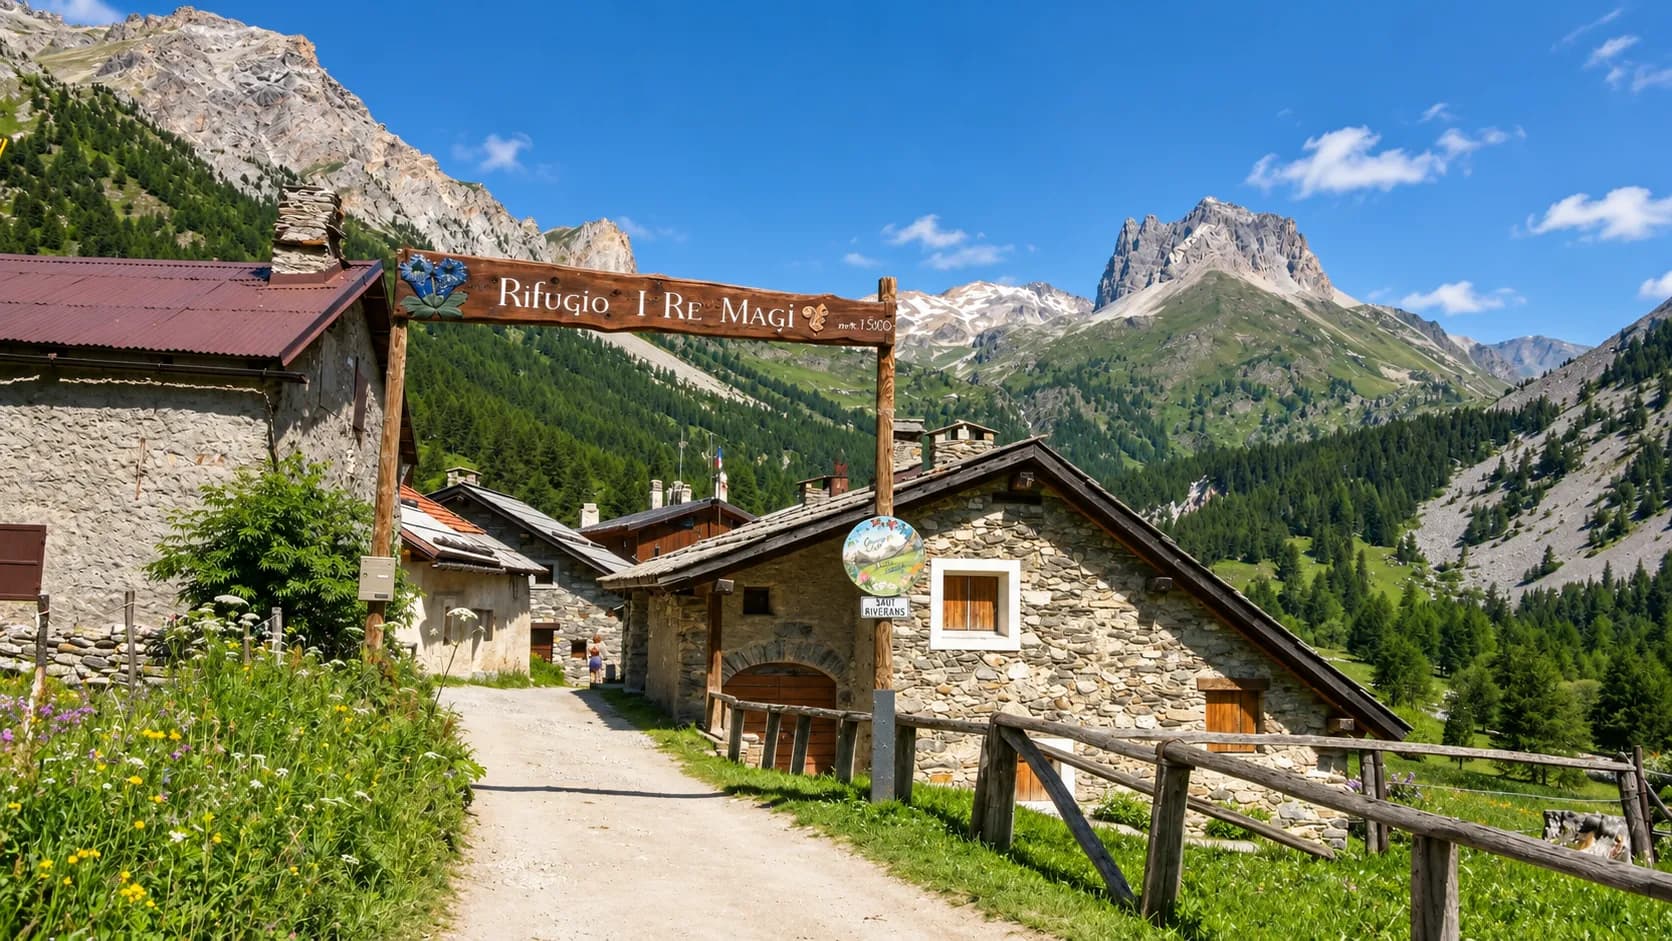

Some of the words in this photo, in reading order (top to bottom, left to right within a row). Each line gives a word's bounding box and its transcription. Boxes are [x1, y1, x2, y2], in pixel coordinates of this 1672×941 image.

[496, 277, 610, 316] Rifugio
[636, 290, 647, 316] I
[875, 598, 895, 607] SAUT
[864, 607, 905, 617] RIVERANS
